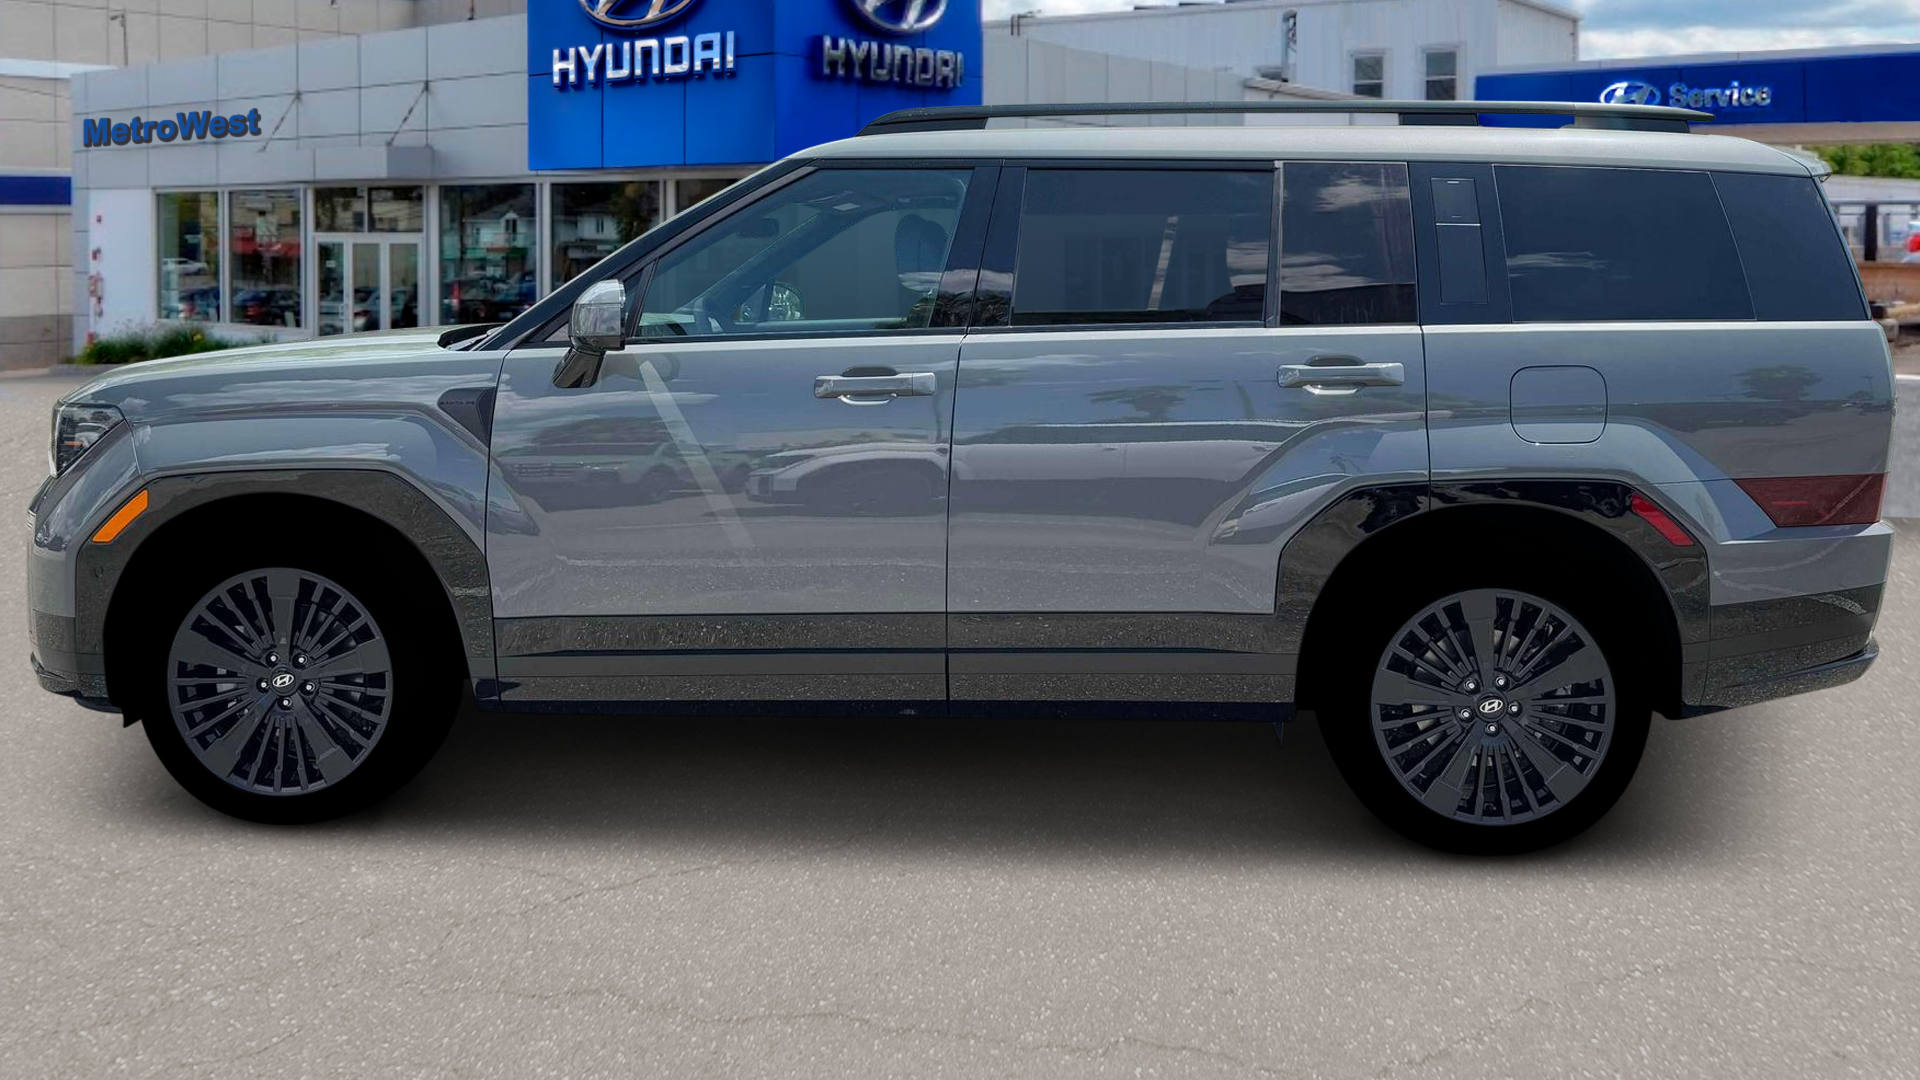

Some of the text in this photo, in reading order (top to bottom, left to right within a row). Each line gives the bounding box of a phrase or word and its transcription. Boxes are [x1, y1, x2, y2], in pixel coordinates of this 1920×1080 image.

[553, 31, 735, 84] HYUNDAI
[823, 35, 964, 88] HYUNDAI
[1669, 81, 1771, 108] Service
[83, 108, 262, 148] MetroWest
